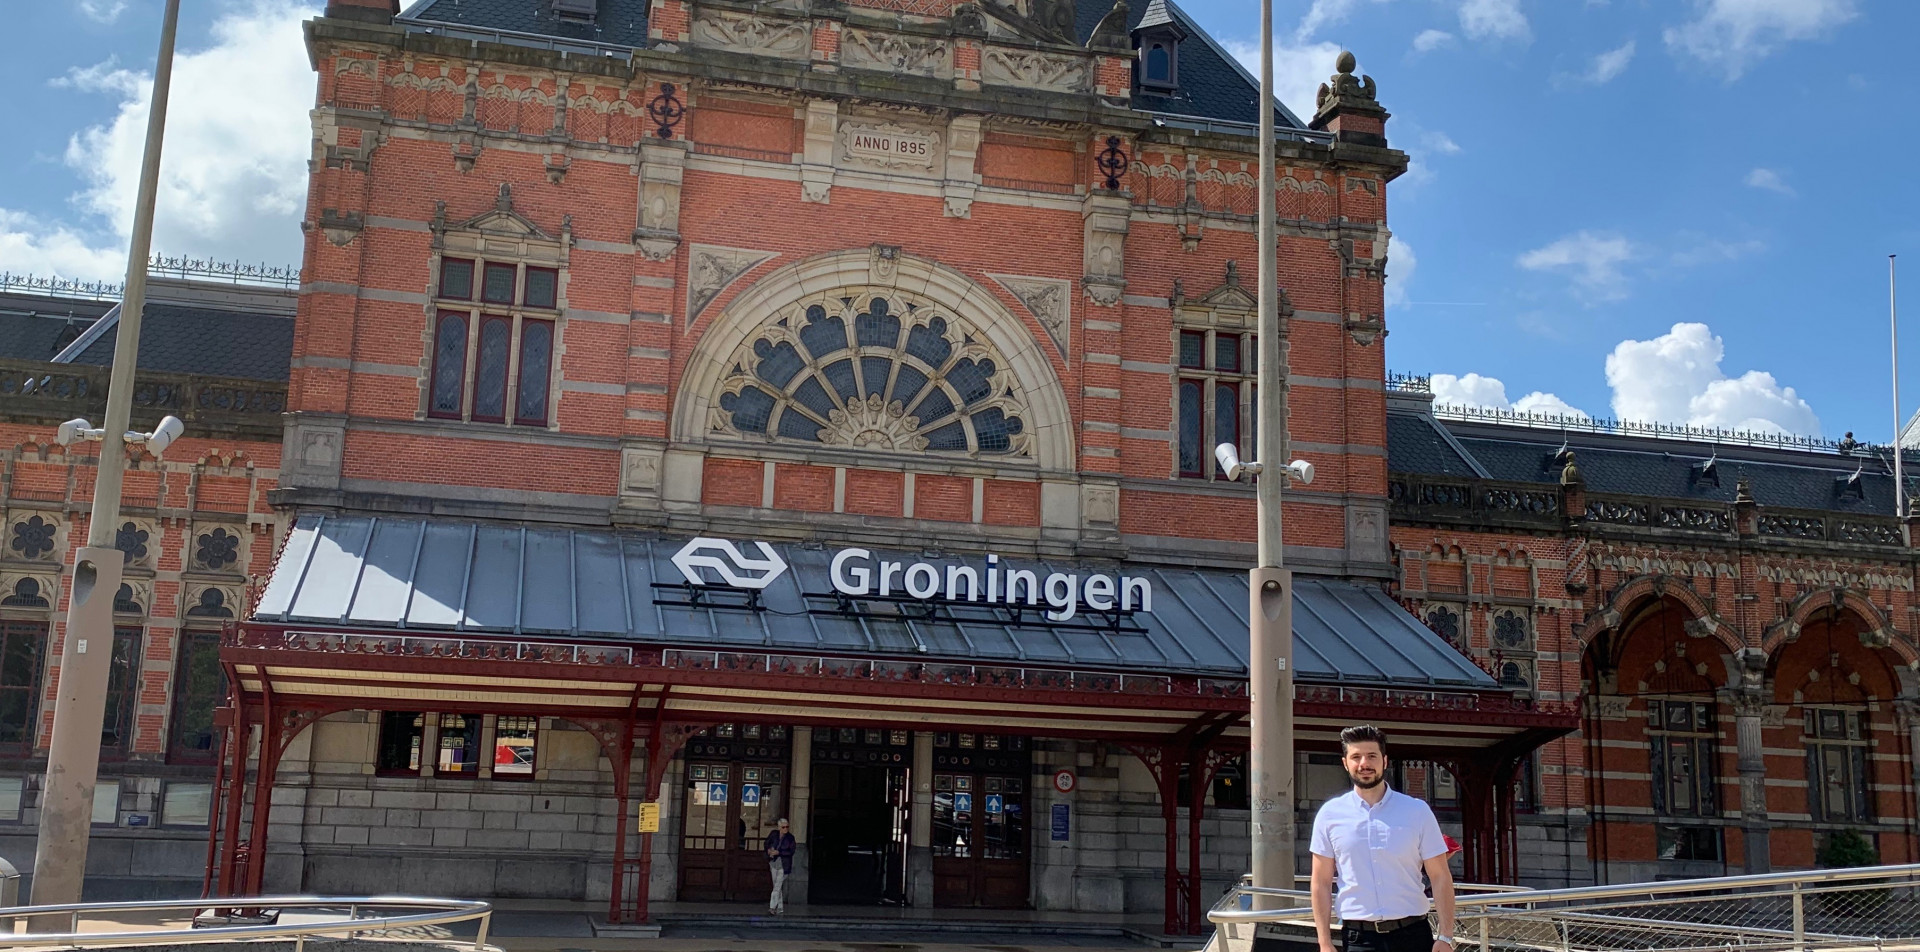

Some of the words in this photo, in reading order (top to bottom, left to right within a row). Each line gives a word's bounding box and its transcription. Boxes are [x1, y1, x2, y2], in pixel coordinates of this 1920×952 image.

[855, 135, 890, 151] ANNO
[896, 140, 926, 155] 1895
[829, 548, 1152, 621] Groningen
